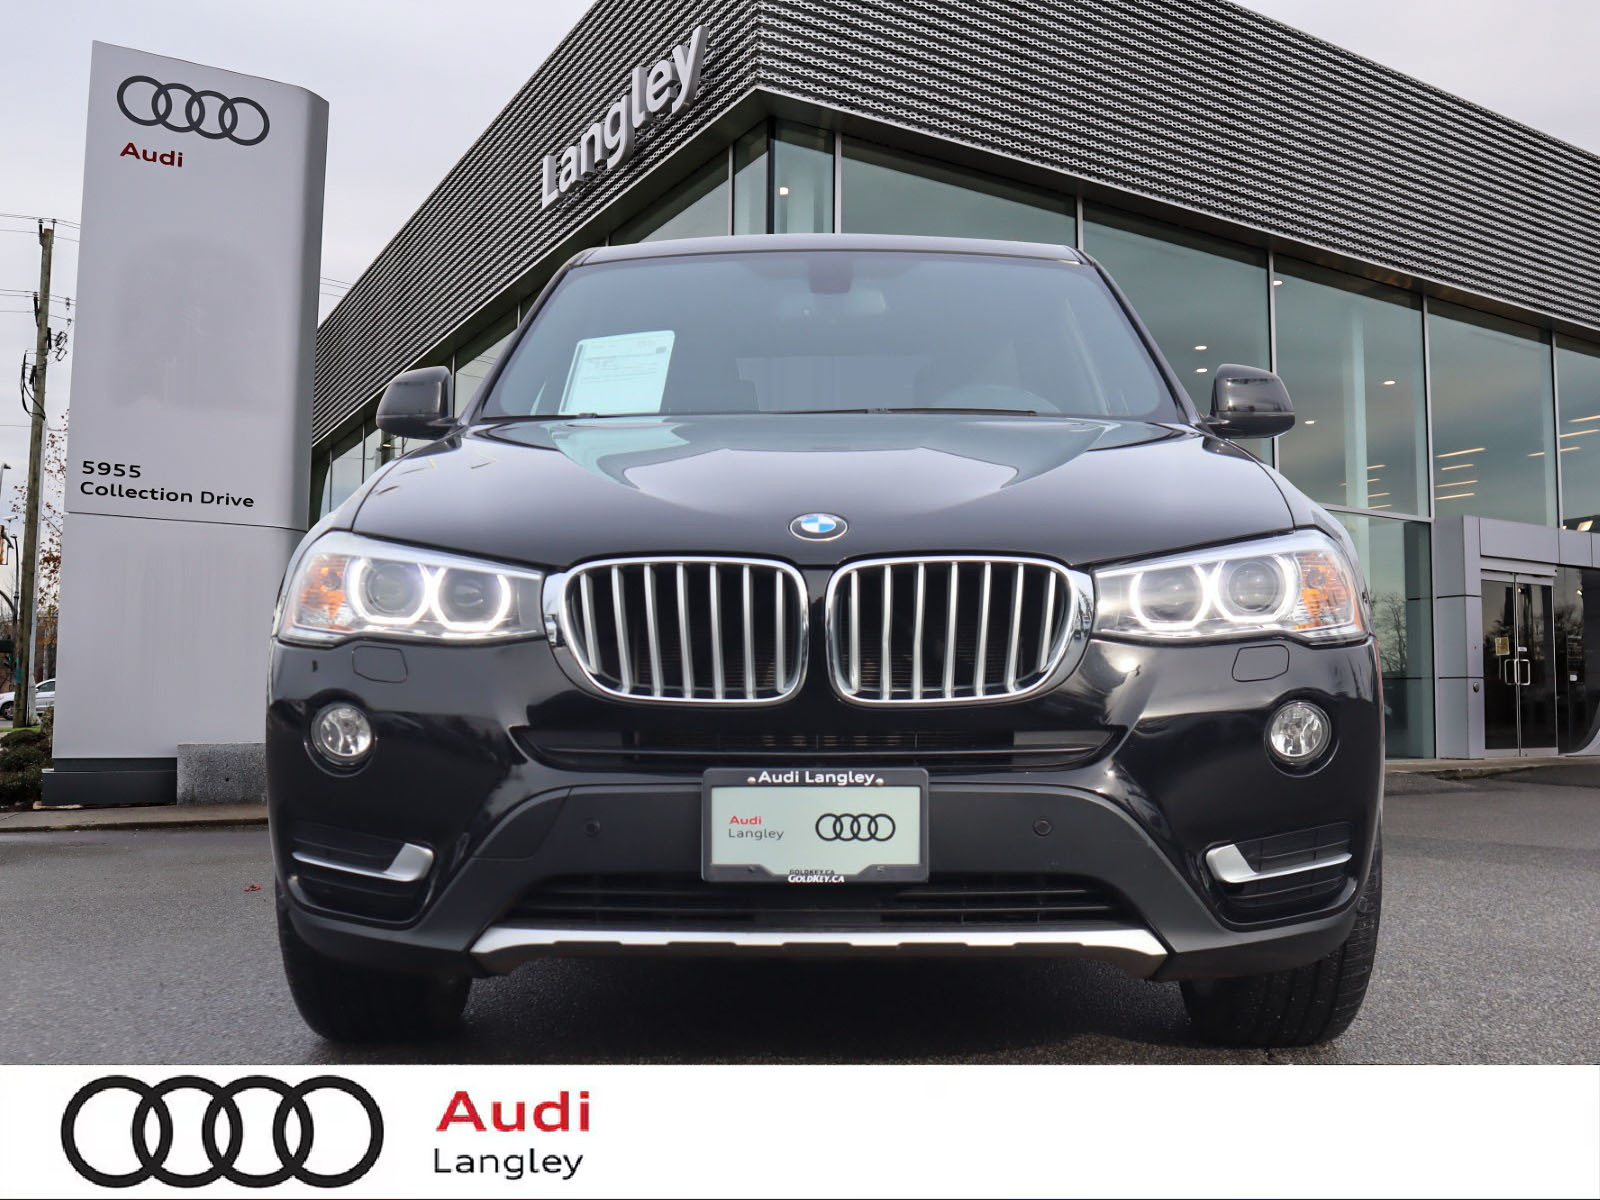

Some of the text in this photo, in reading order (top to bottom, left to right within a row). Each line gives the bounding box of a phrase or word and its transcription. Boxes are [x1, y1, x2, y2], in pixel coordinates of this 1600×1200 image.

[541, 25, 709, 209] Langley
[120, 142, 183, 168] Audi
[82, 460, 141, 478] 5955
[80, 481, 254, 507] Collection Drive
[758, 771, 875, 786] Audi Langley
[729, 815, 762, 825] Audi
[728, 828, 785, 840] Langley
